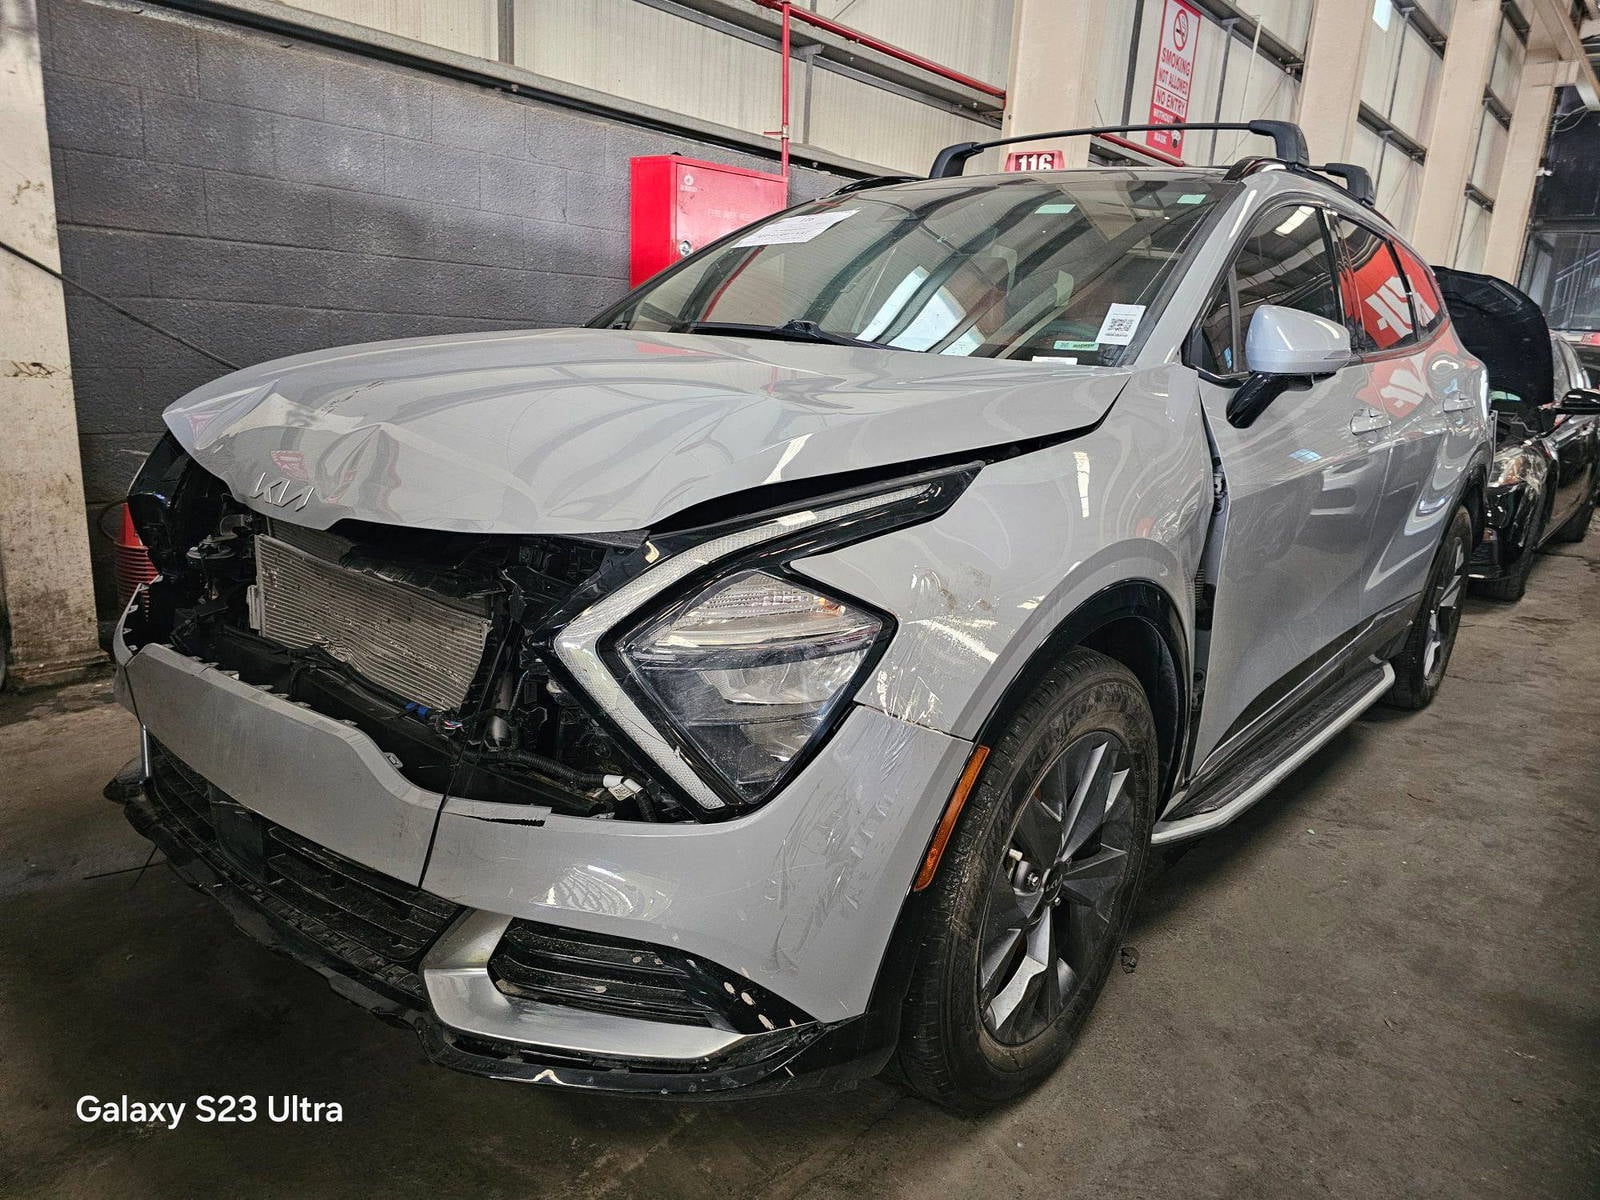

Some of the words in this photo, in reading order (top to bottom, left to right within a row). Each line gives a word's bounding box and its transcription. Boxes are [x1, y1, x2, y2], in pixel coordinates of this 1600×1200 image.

[1162, 47, 1191, 76] SMOKING
[1159, 68, 1169, 85] NOT
[1169, 72, 1189, 96] ALLOWED
[1156, 88, 1165, 105] NO
[1166, 94, 1186, 116] ENTRY
[1019, 153, 1053, 171] 116
[249, 471, 316, 512] KIA
